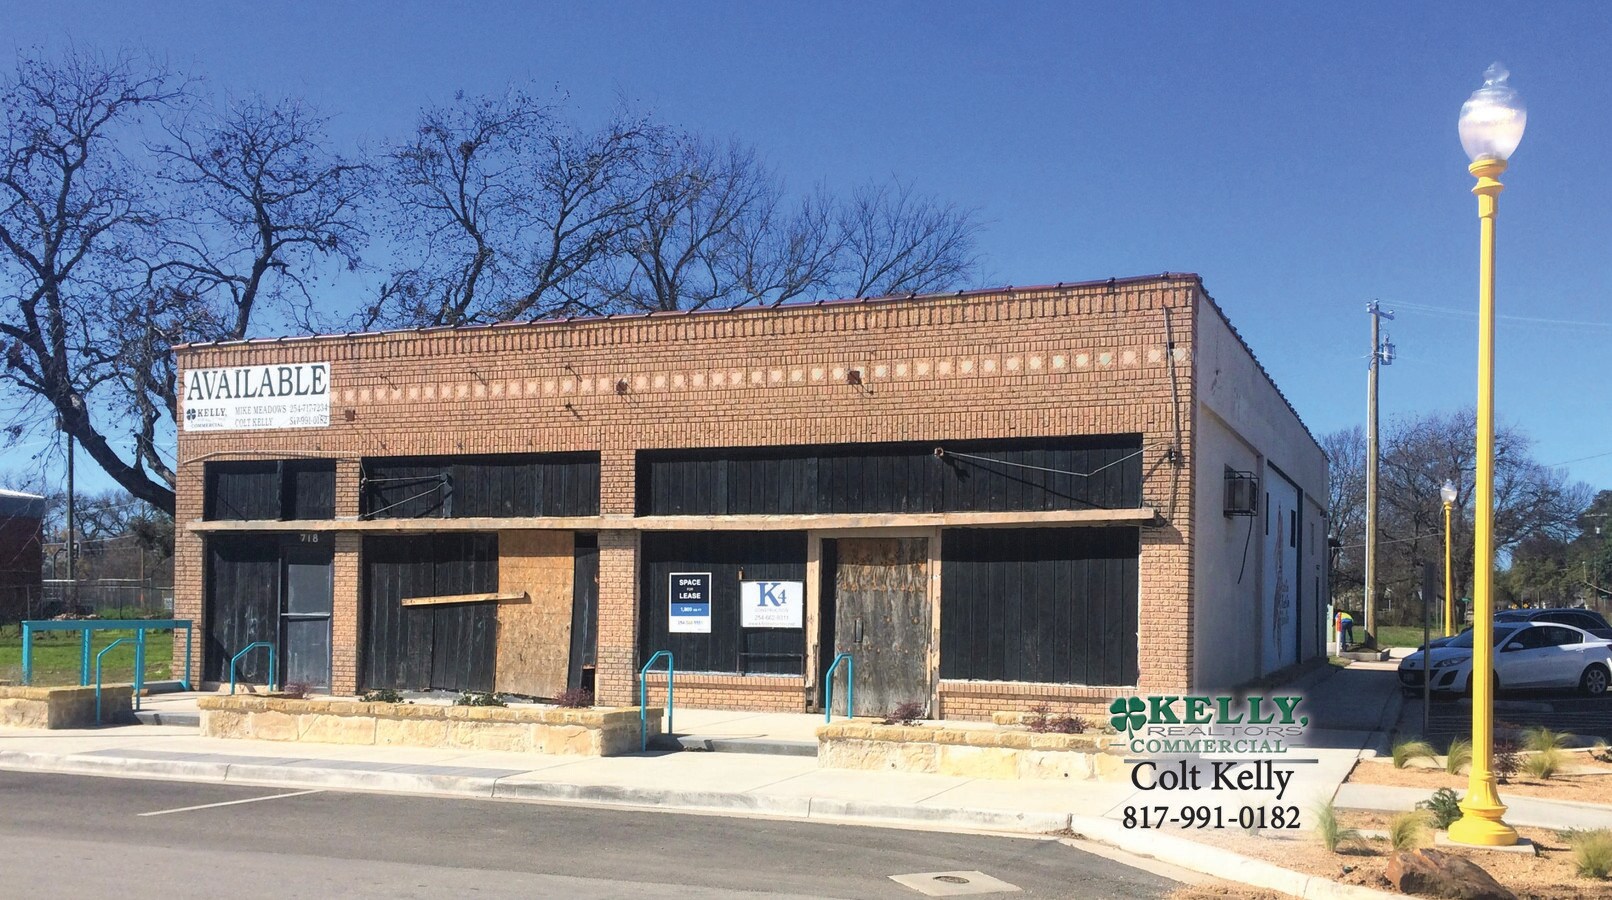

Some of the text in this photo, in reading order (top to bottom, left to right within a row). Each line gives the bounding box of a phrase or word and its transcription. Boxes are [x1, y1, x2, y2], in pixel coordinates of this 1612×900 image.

[187, 365, 327, 401] AVAILABLE
[235, 405, 286, 416] MIKE MEADOWS
[235, 417, 273, 428] COLT KELLY
[300, 533, 319, 543] 718
[757, 582, 787, 607] K4
